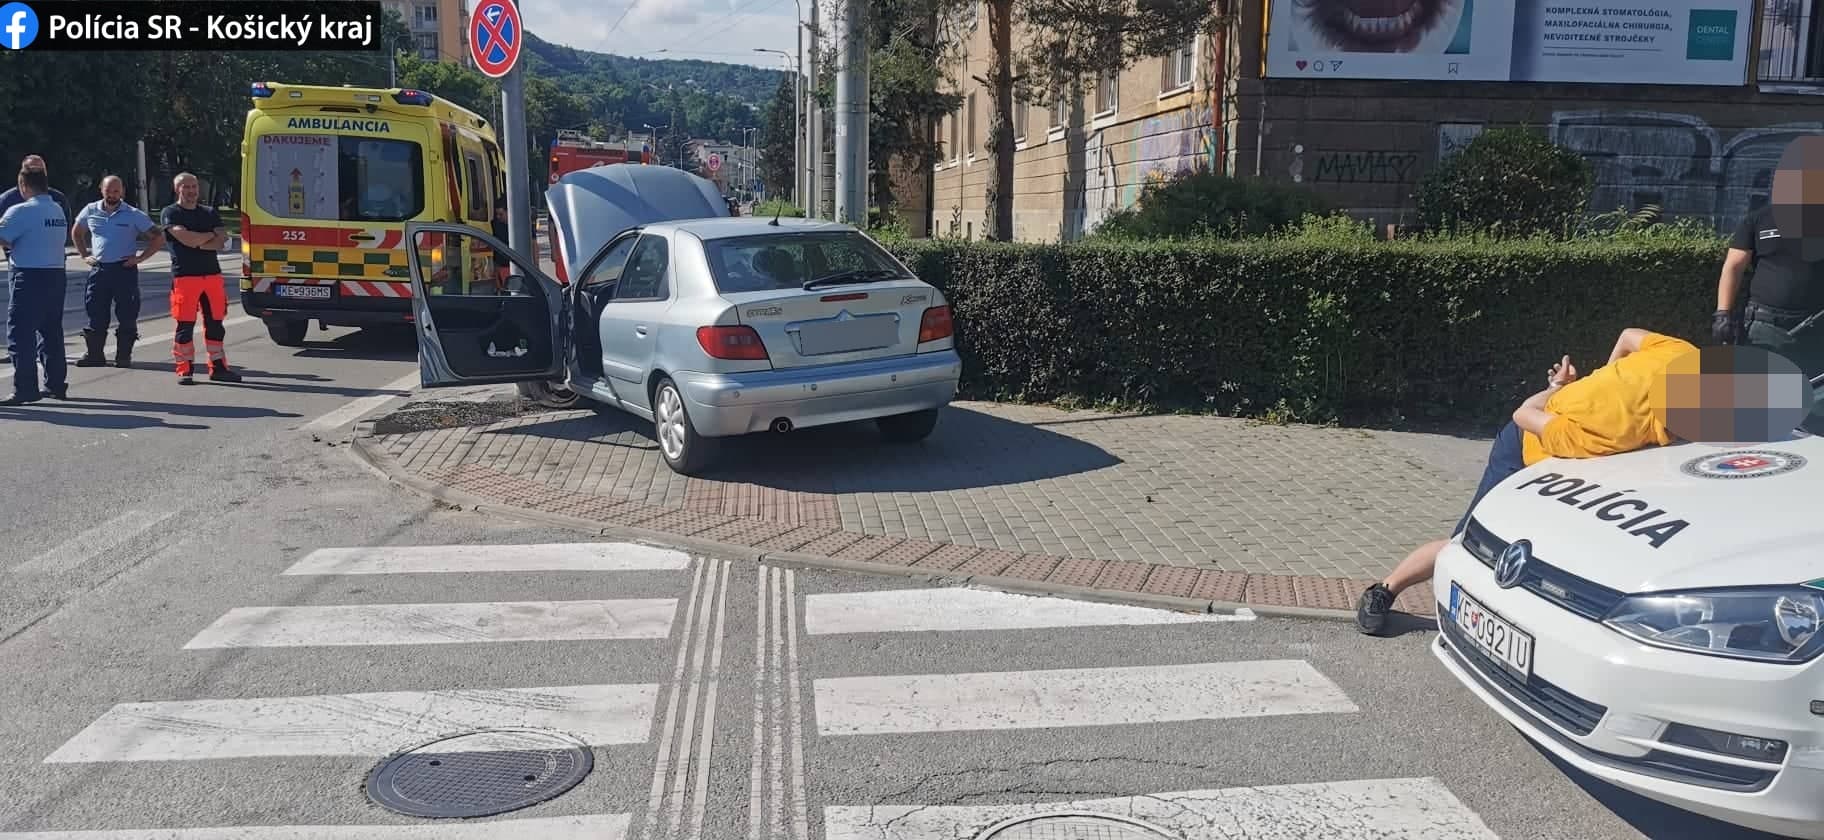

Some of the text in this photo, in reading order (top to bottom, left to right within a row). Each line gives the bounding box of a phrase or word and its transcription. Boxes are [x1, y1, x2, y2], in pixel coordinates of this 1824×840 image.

[1545, 6, 1672, 17] KOMPLEXNÁ STOMATOLÓGIA,
[1623, 22, 1673, 31] CHIRURGIA,
[1696, 25, 1729, 34] DENTAL
[1604, 34, 1656, 44] STROJČEKY
[287, 117, 390, 133] AMBULANCIA
[282, 230, 306, 241] 252
[1516, 472, 1692, 549] POLÍCIA
